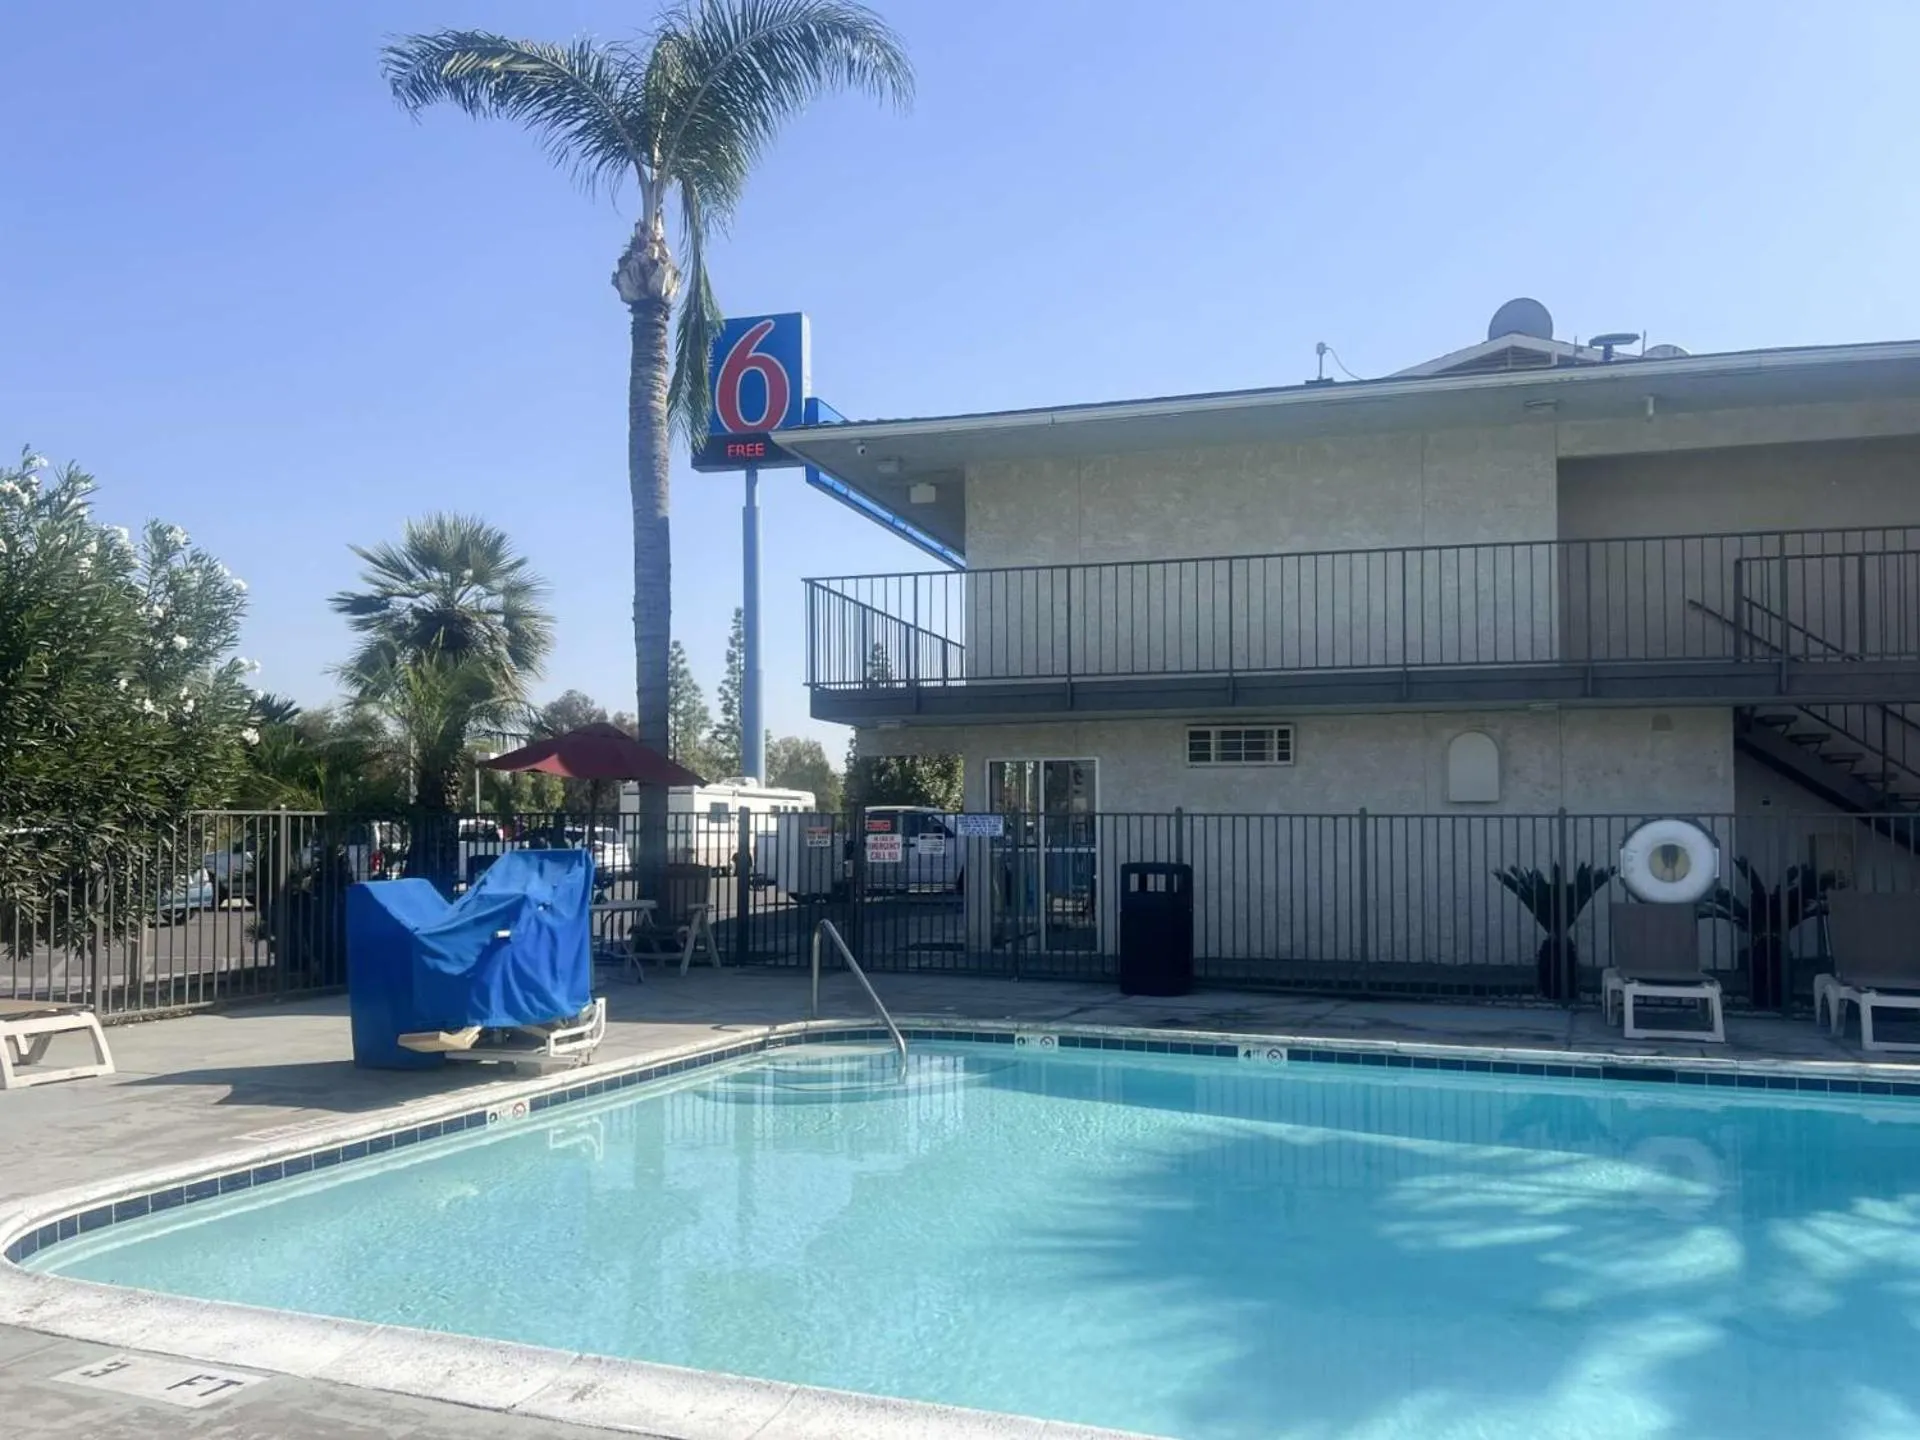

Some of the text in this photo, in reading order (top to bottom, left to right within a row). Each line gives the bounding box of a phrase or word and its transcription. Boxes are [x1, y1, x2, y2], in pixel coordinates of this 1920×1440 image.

[715, 319, 790, 434] 6
[727, 442, 766, 458] FREE
[165, 1374, 244, 1397] FT
